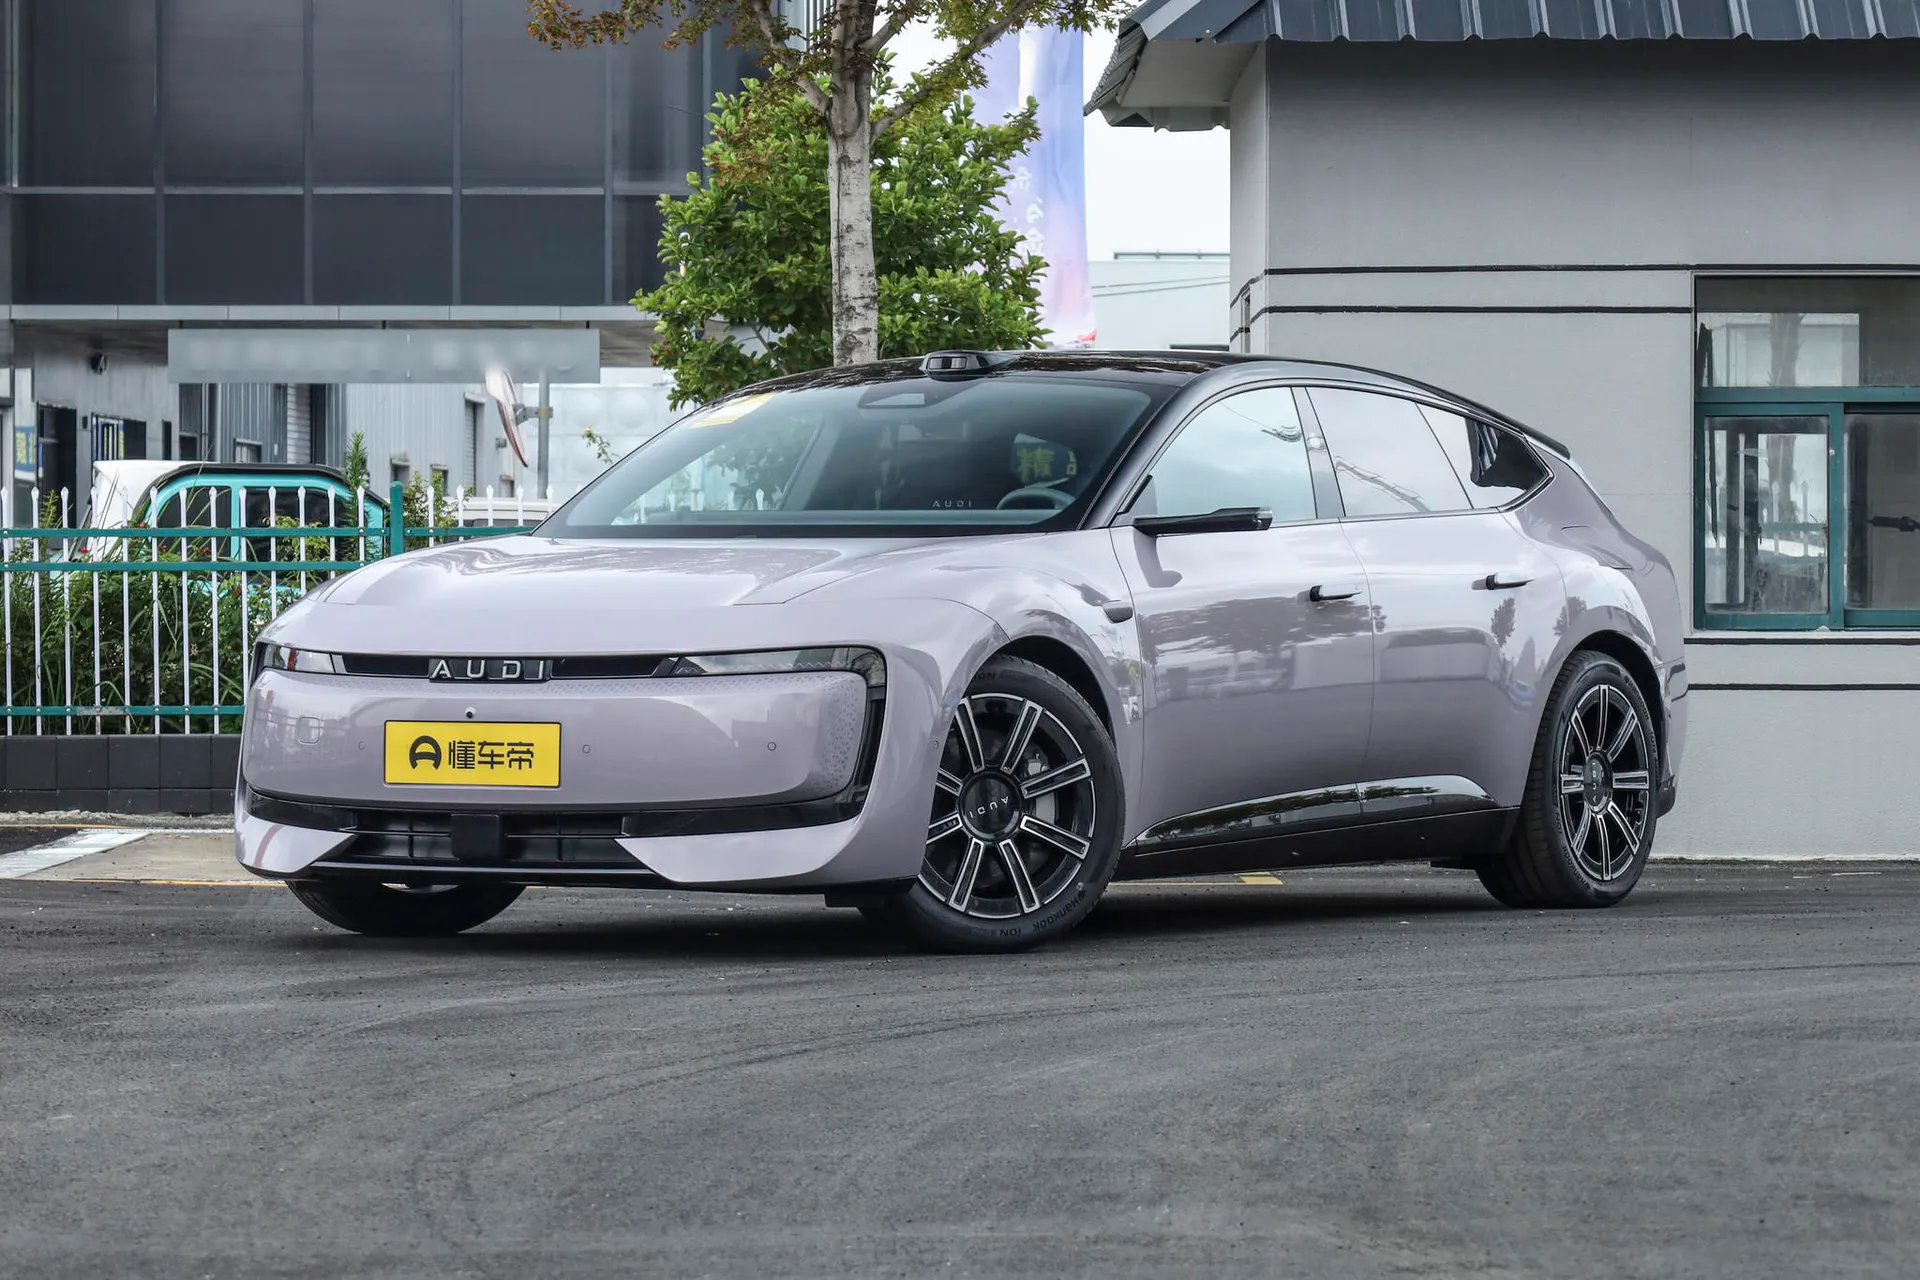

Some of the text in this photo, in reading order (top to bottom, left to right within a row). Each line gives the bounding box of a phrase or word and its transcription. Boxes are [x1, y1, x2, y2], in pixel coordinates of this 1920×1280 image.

[933, 500, 972, 508] AUDI
[431, 658, 545, 680] AUDI
[448, 740, 535, 770] 懂车帝
[969, 796, 1009, 819] AUDI
